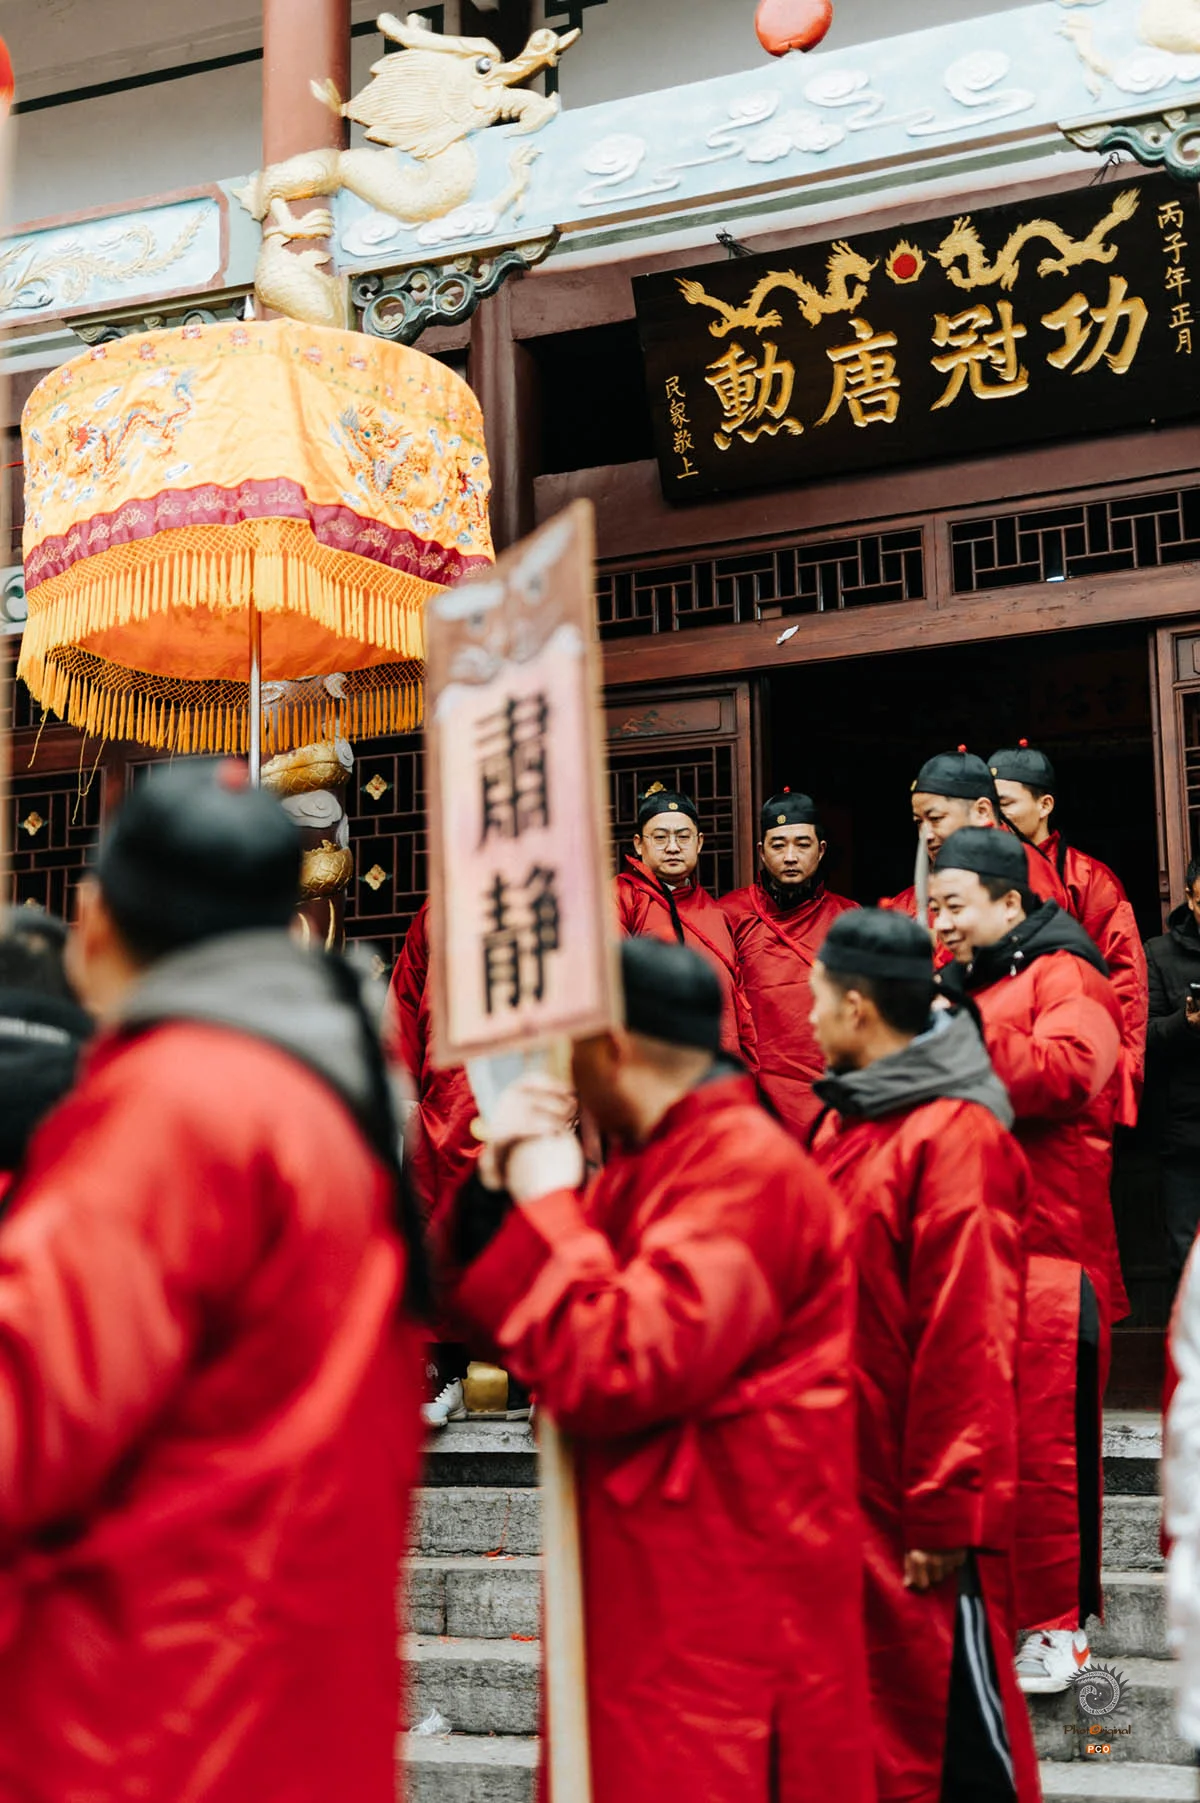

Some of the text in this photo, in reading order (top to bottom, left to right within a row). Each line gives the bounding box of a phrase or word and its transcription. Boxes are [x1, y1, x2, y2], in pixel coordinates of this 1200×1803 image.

[1157, 200, 1195, 354] 丙子年正月
